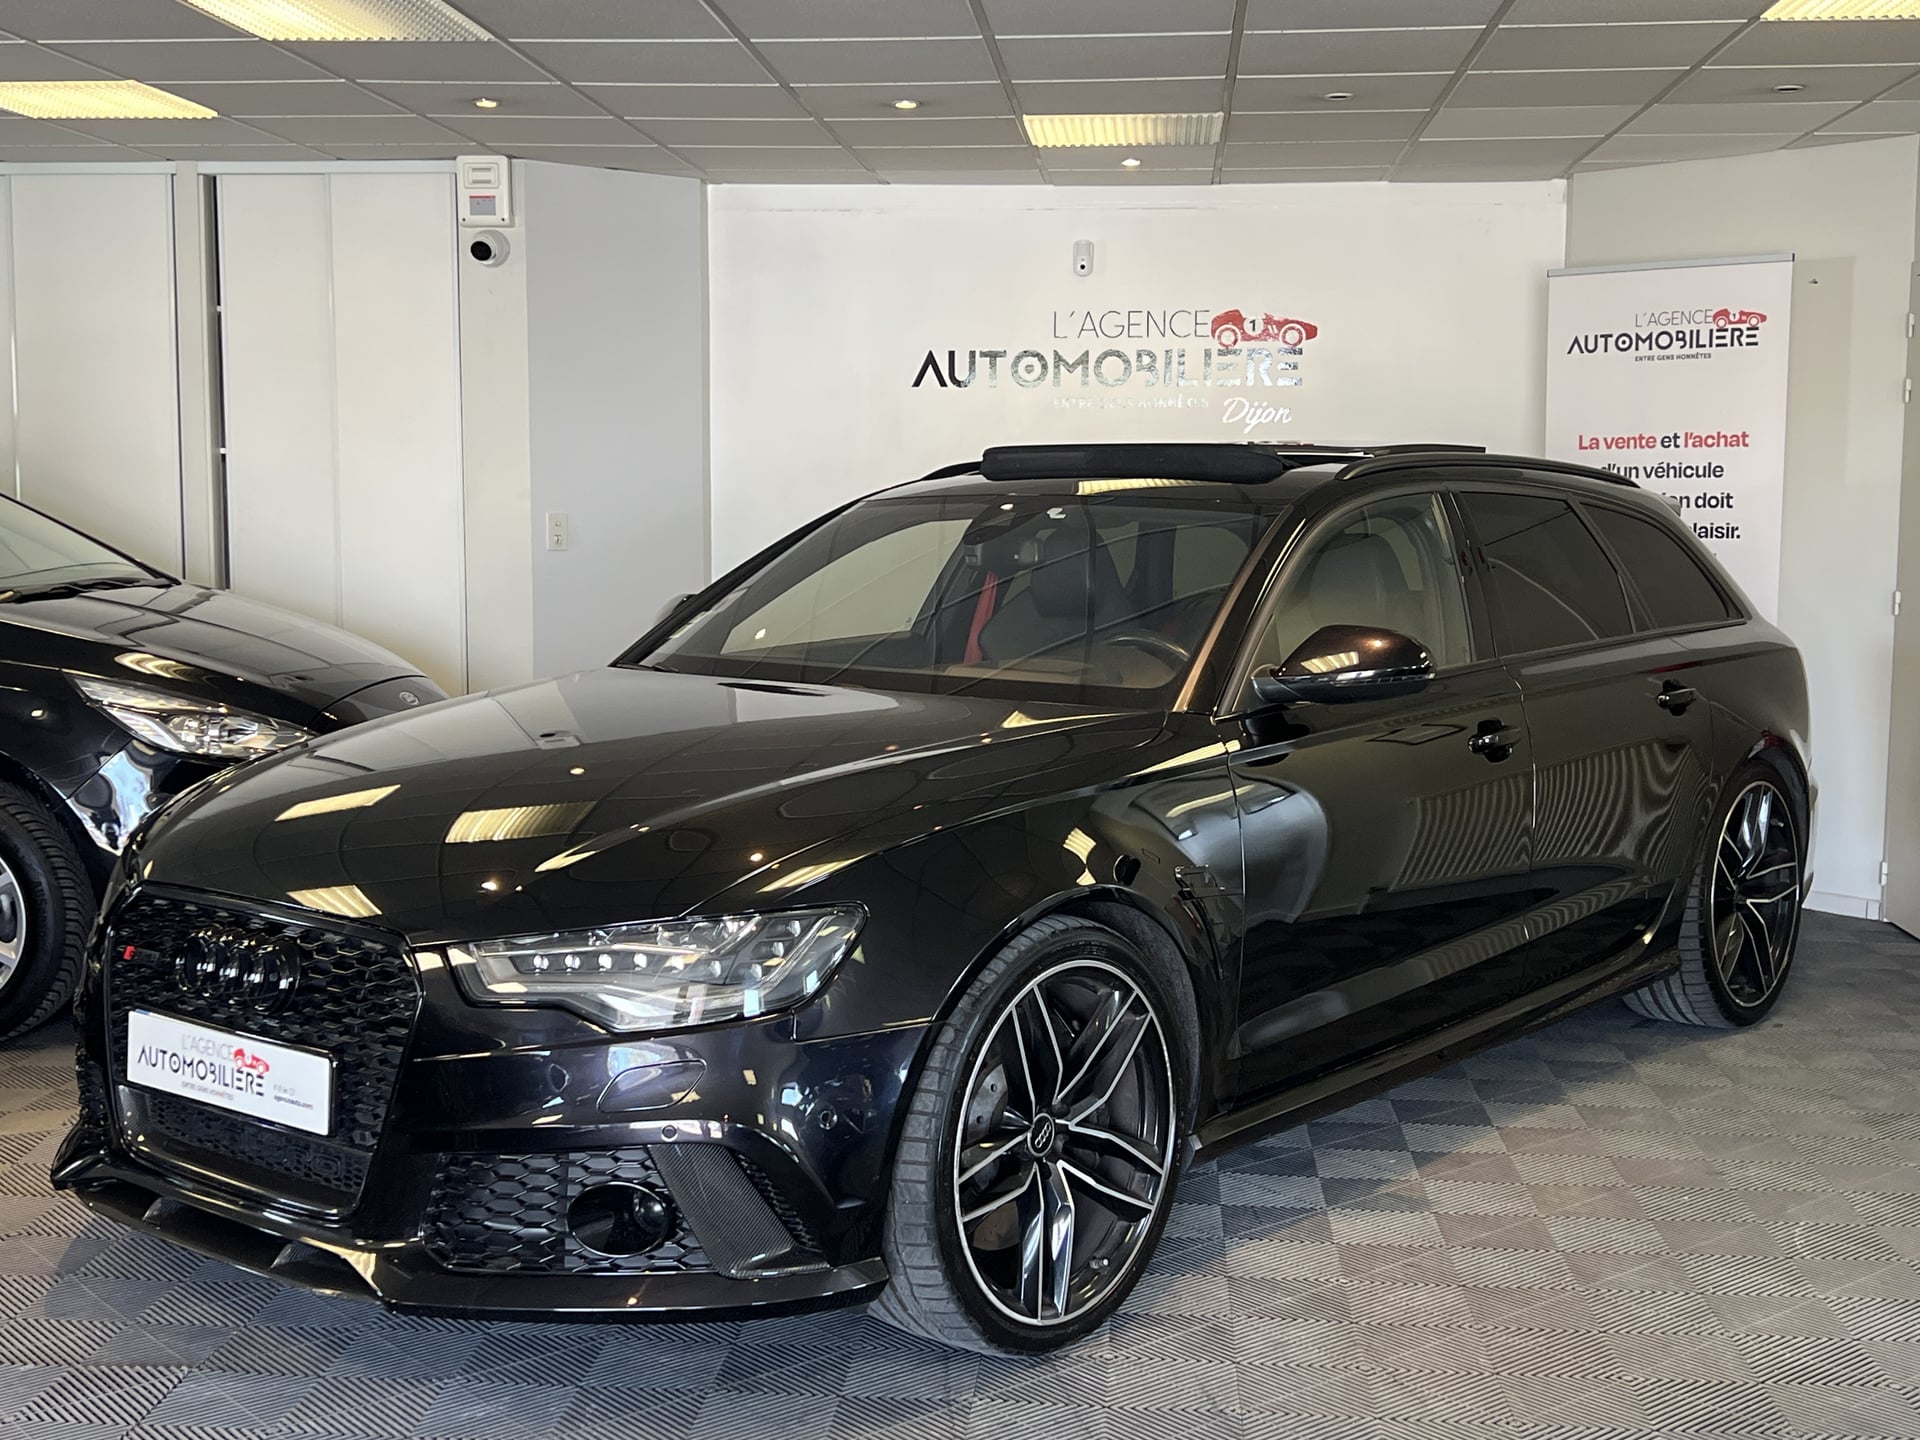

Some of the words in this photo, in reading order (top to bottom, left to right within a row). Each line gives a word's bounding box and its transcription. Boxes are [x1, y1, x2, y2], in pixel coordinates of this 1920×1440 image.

[1052, 309, 1211, 340] L'AGENCE
[1248, 318, 1258, 333] 1
[1634, 308, 1714, 328] L'AGENCE
[1675, 351, 1712, 361] HONNÊTES
[1222, 396, 1292, 435] Dijon
[1578, 434, 1600, 450] La
[1603, 432, 1657, 450] vente
[1660, 432, 1681, 449] et
[1684, 431, 1750, 449] l'achat
[1643, 461, 1725, 479] véhicule
[1694, 492, 1734, 509] doit
[1689, 522, 1741, 539] laisir.
